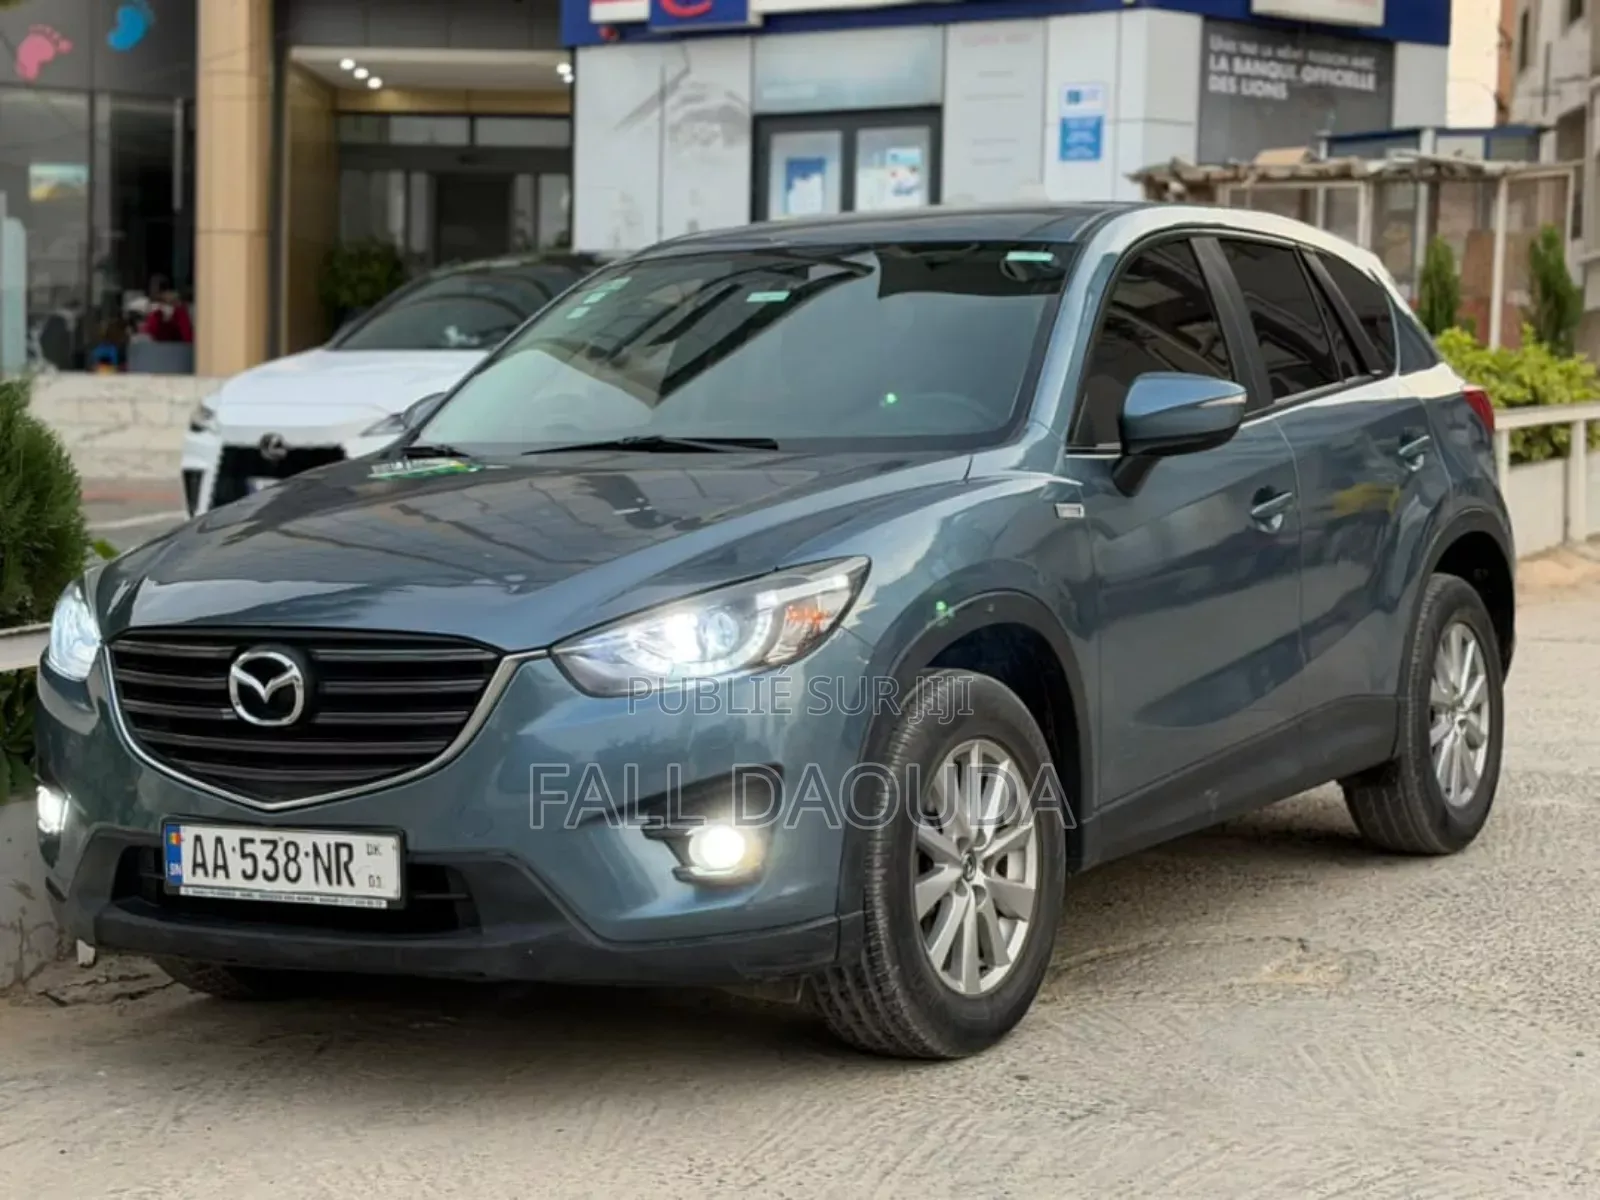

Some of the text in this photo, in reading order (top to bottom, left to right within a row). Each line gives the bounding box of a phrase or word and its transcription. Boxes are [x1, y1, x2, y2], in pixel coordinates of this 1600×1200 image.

[1208, 74, 1287, 100] DES LIONS
[1209, 53, 1376, 92] LA BANQUE OFFICIELLE
